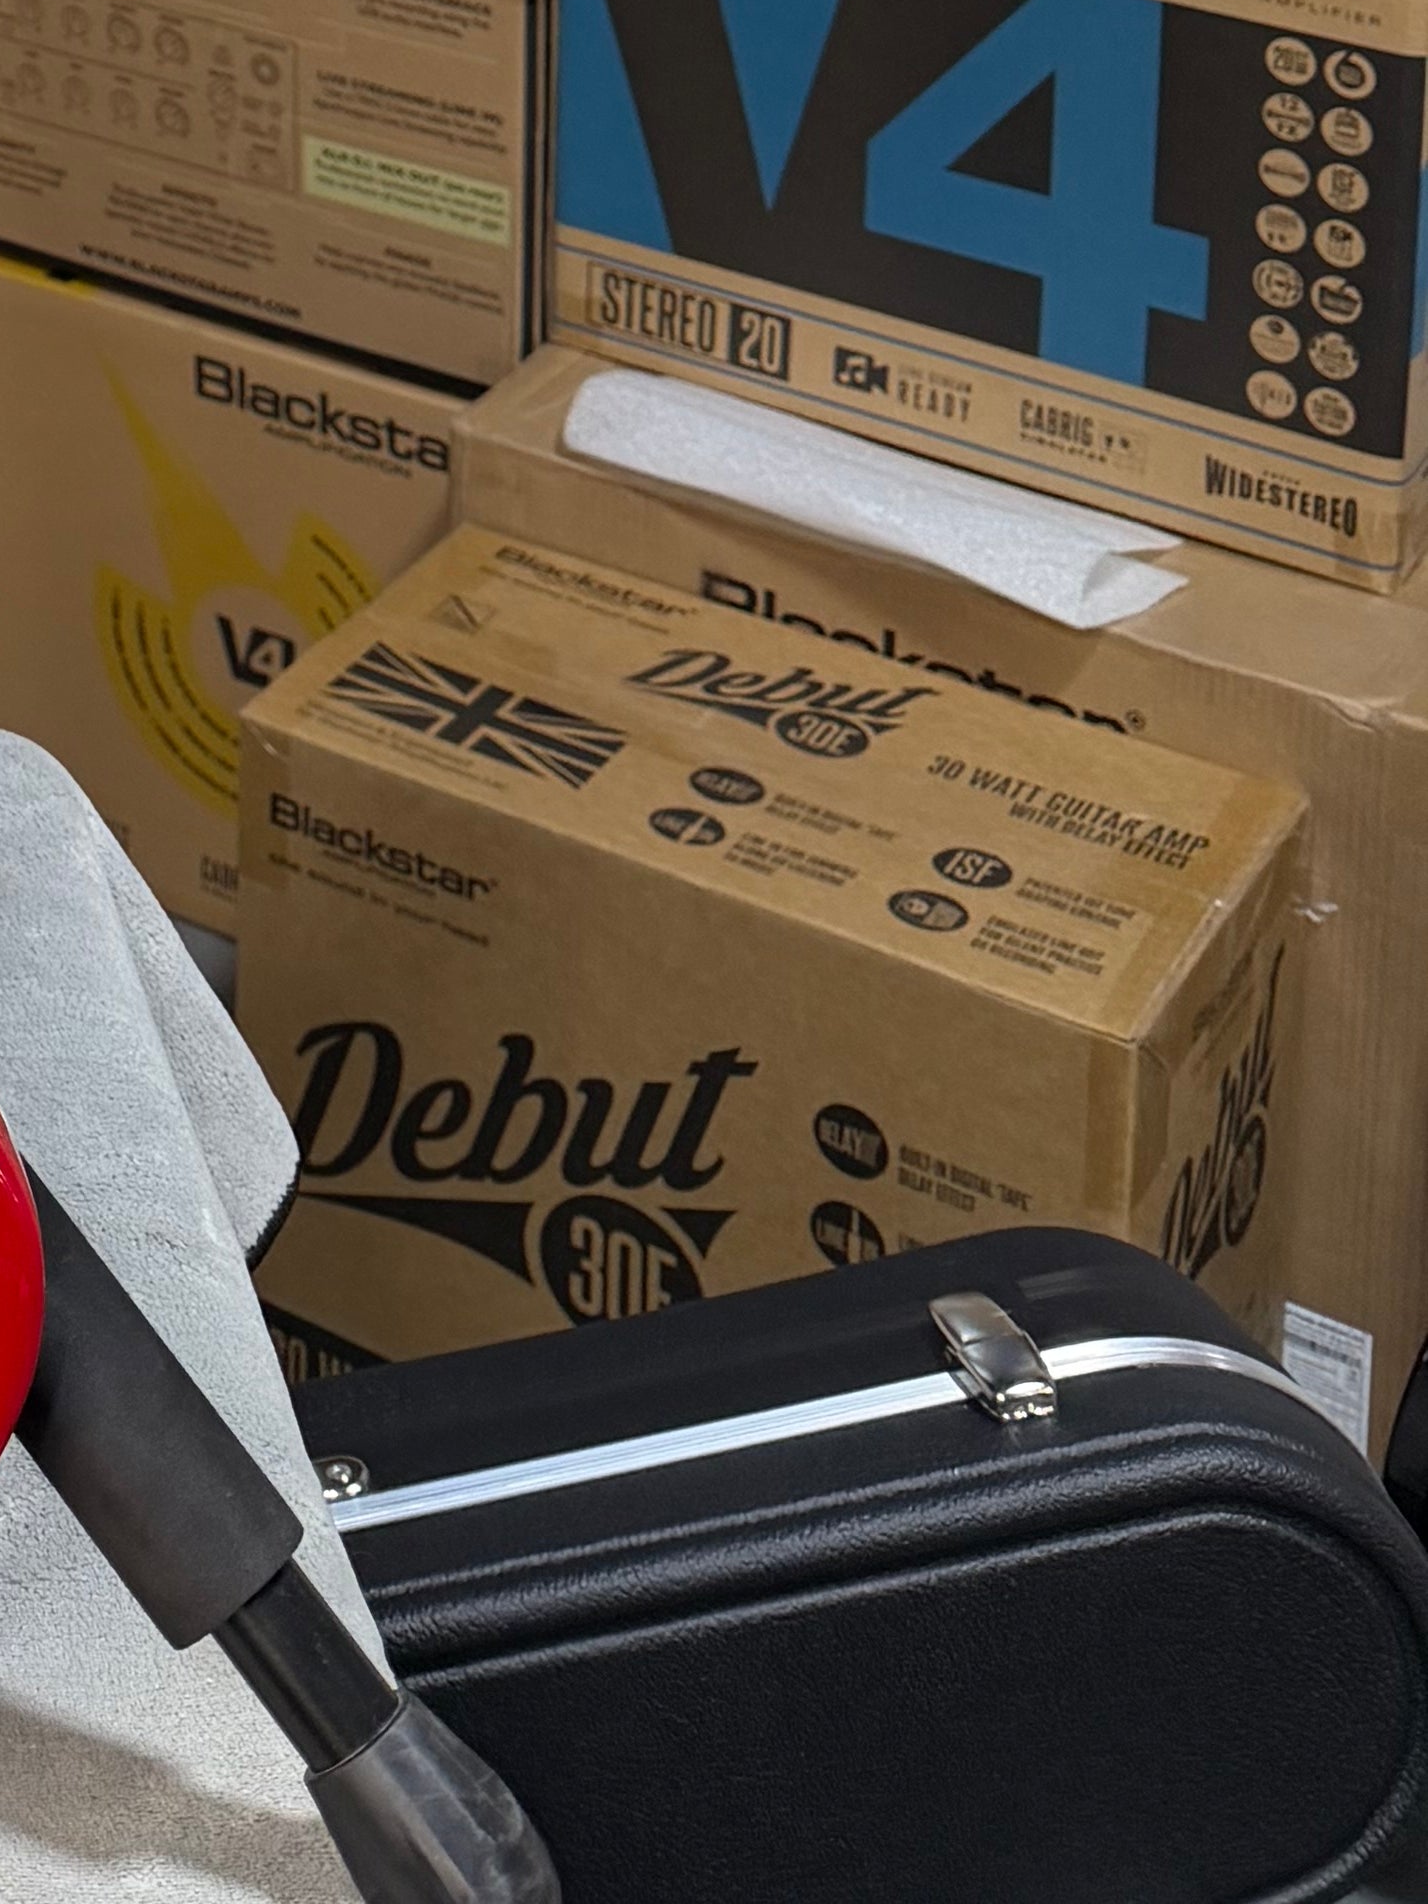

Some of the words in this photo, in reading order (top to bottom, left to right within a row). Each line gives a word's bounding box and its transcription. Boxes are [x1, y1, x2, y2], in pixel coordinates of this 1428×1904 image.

[598, 270, 718, 356] STEREO
[736, 313, 783, 378] 20
[195, 354, 450, 475] Blacksta
[896, 376, 973, 424] READY
[1019, 398, 1095, 449] CABRIG
[1204, 453, 1359, 539] WIDESTEREO
[494, 545, 691, 617] Blackstar
[625, 647, 945, 721] Debut
[786, 712, 853, 756] 30E
[927, 754, 966, 782] 30
[969, 766, 1043, 805] WATT
[1044, 790, 1145, 837] GUITAR
[1144, 826, 1212, 856] AMP
[1007, 800, 1058, 830] WITH
[1060, 815, 1125, 849] DELAY
[1122, 839, 1193, 872] EFFECT
[269, 791, 491, 902] Blackstar
[944, 849, 1003, 885] ISF
[295, 1020, 760, 1192] Debut
